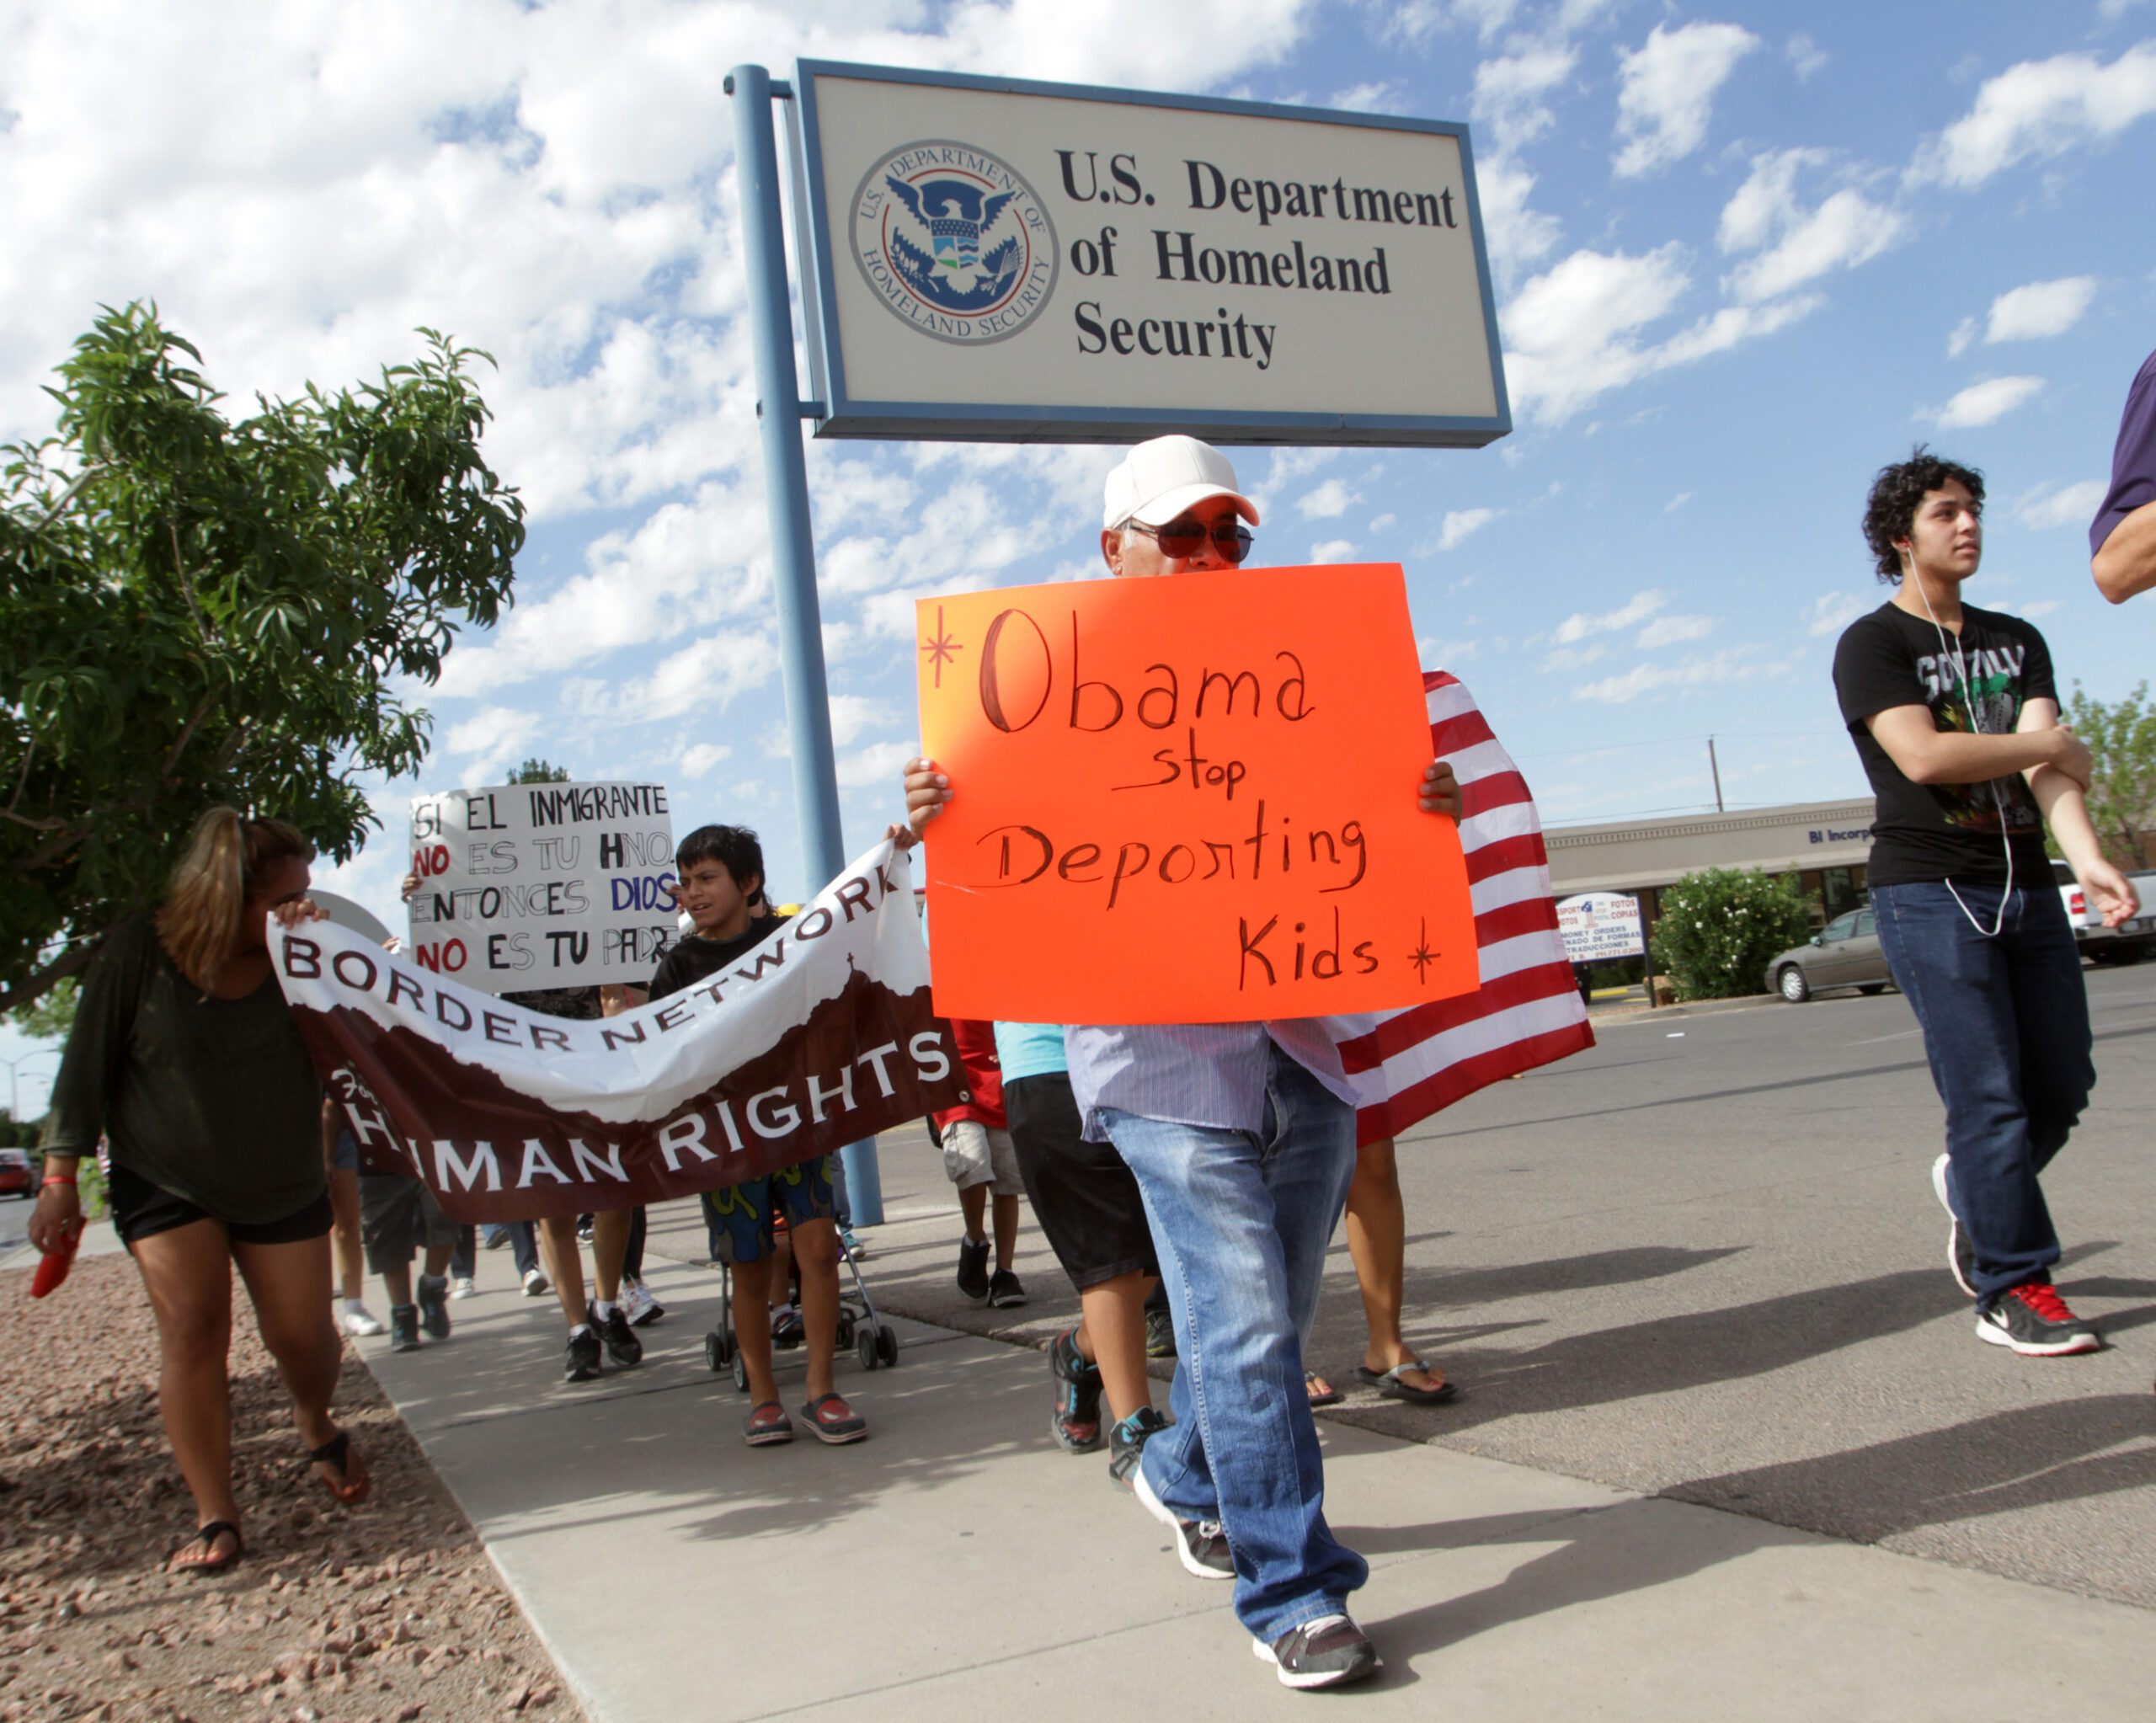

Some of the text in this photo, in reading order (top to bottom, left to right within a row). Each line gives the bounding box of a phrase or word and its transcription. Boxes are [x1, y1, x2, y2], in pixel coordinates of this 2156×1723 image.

[861, 147, 1045, 233] U.S. DEPARTMENT OF
[1054, 150, 1458, 229] U.S. Department
[1070, 226, 1391, 295] of Homeland
[863, 249, 1049, 337] HOMELAND SECURITY
[1074, 301, 1277, 370] Security
[979, 609, 1315, 732] Obama
[415, 786, 668, 840] SI EL INMIGRANTE
[414, 845, 450, 877] NO
[468, 841, 518, 875] ES
[532, 836, 580, 870] TU
[968, 798, 1366, 911] Deporting
[410, 872, 677, 923] ENTONCES DIOS
[1559, 917, 1578, 926] OTOS
[1611, 899, 1636, 908] FOTOS
[1611, 910, 1638, 920] COPIAS
[282, 865, 898, 1052] BORDER NETWORK
[416, 938, 467, 974] NO
[488, 933, 535, 970] ES
[546, 931, 589, 968] TU
[1240, 906, 1379, 990] Kids
[1561, 926, 1626, 938] MONEY ORDERS
[1566, 941, 1629, 953] TRADUCCIONES
[1608, 931, 1641, 940] FORMAS
[659, 1032, 951, 1171] RIGHTS
